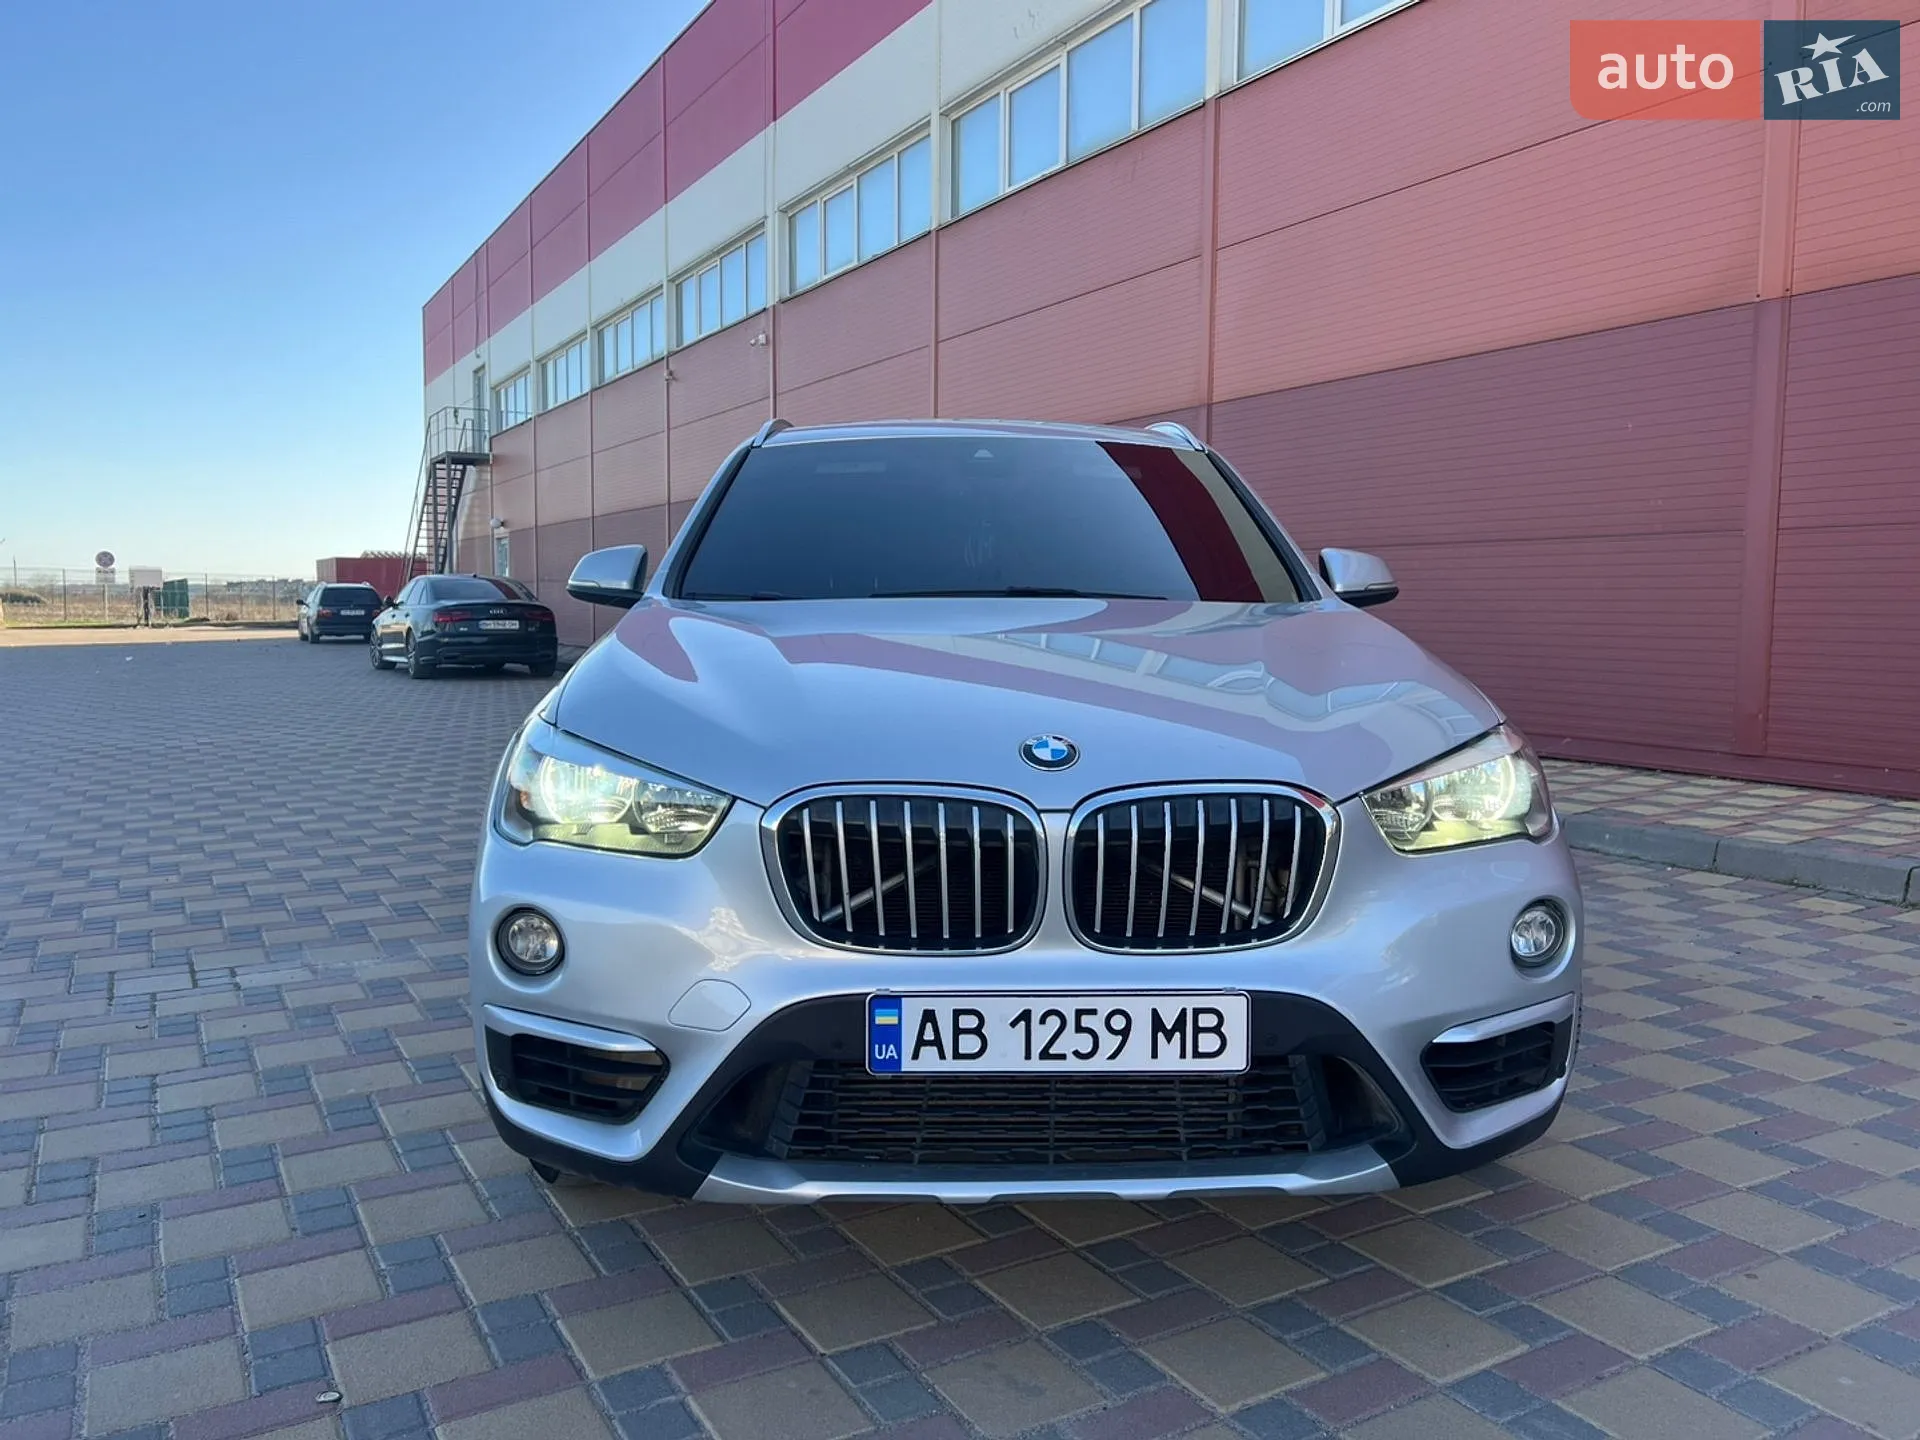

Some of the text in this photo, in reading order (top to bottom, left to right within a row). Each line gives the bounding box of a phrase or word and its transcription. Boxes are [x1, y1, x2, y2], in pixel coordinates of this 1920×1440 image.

[874, 1043, 899, 1060] UA
[910, 1007, 1228, 1061] AB 1259 MB
